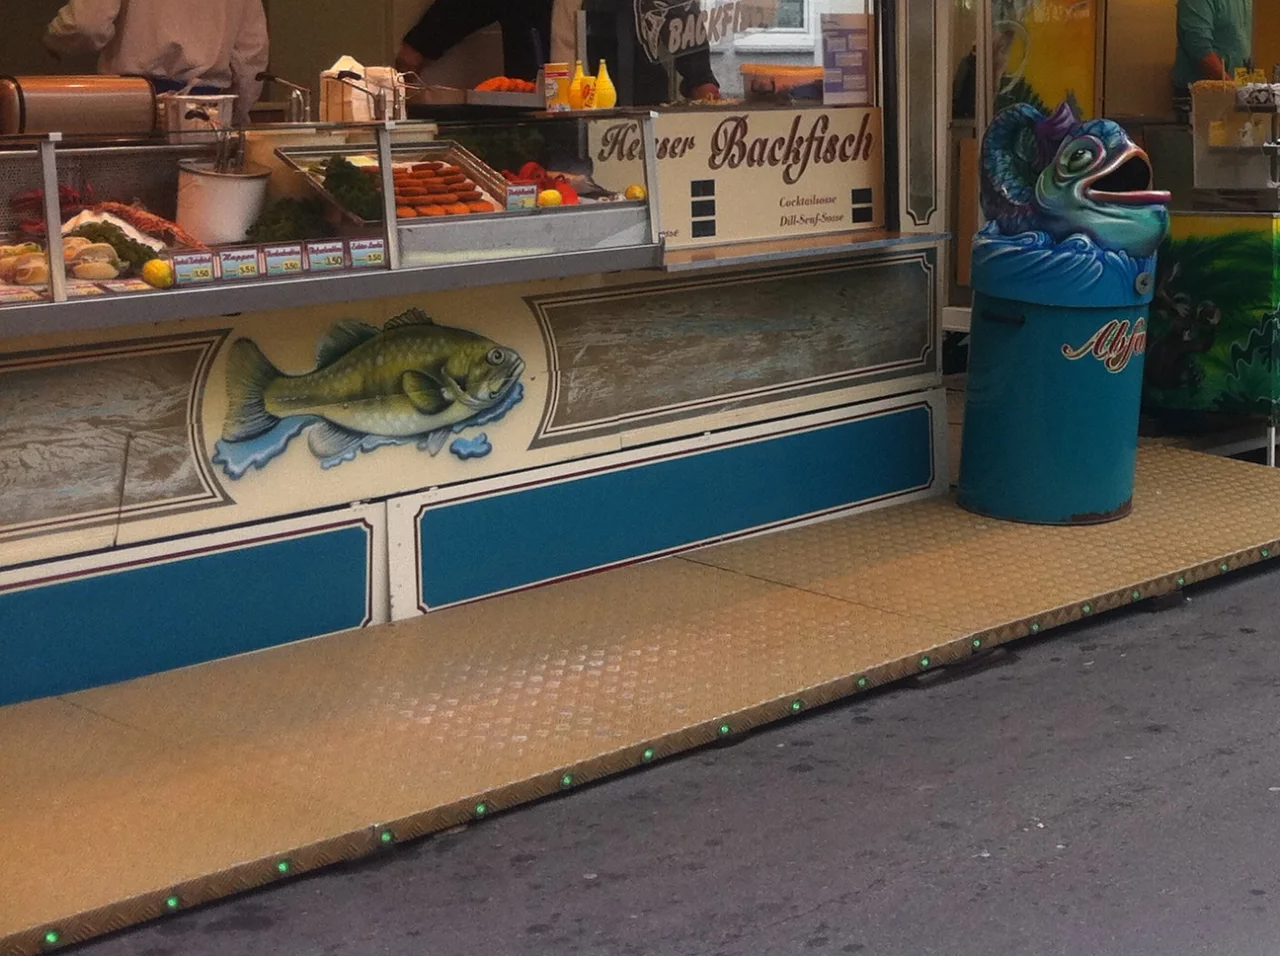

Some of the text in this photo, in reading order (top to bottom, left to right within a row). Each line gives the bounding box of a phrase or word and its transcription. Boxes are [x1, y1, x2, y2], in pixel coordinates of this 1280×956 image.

[668, 1, 770, 54] BACKFI
[597, 112, 875, 185] Heser Backfisch
